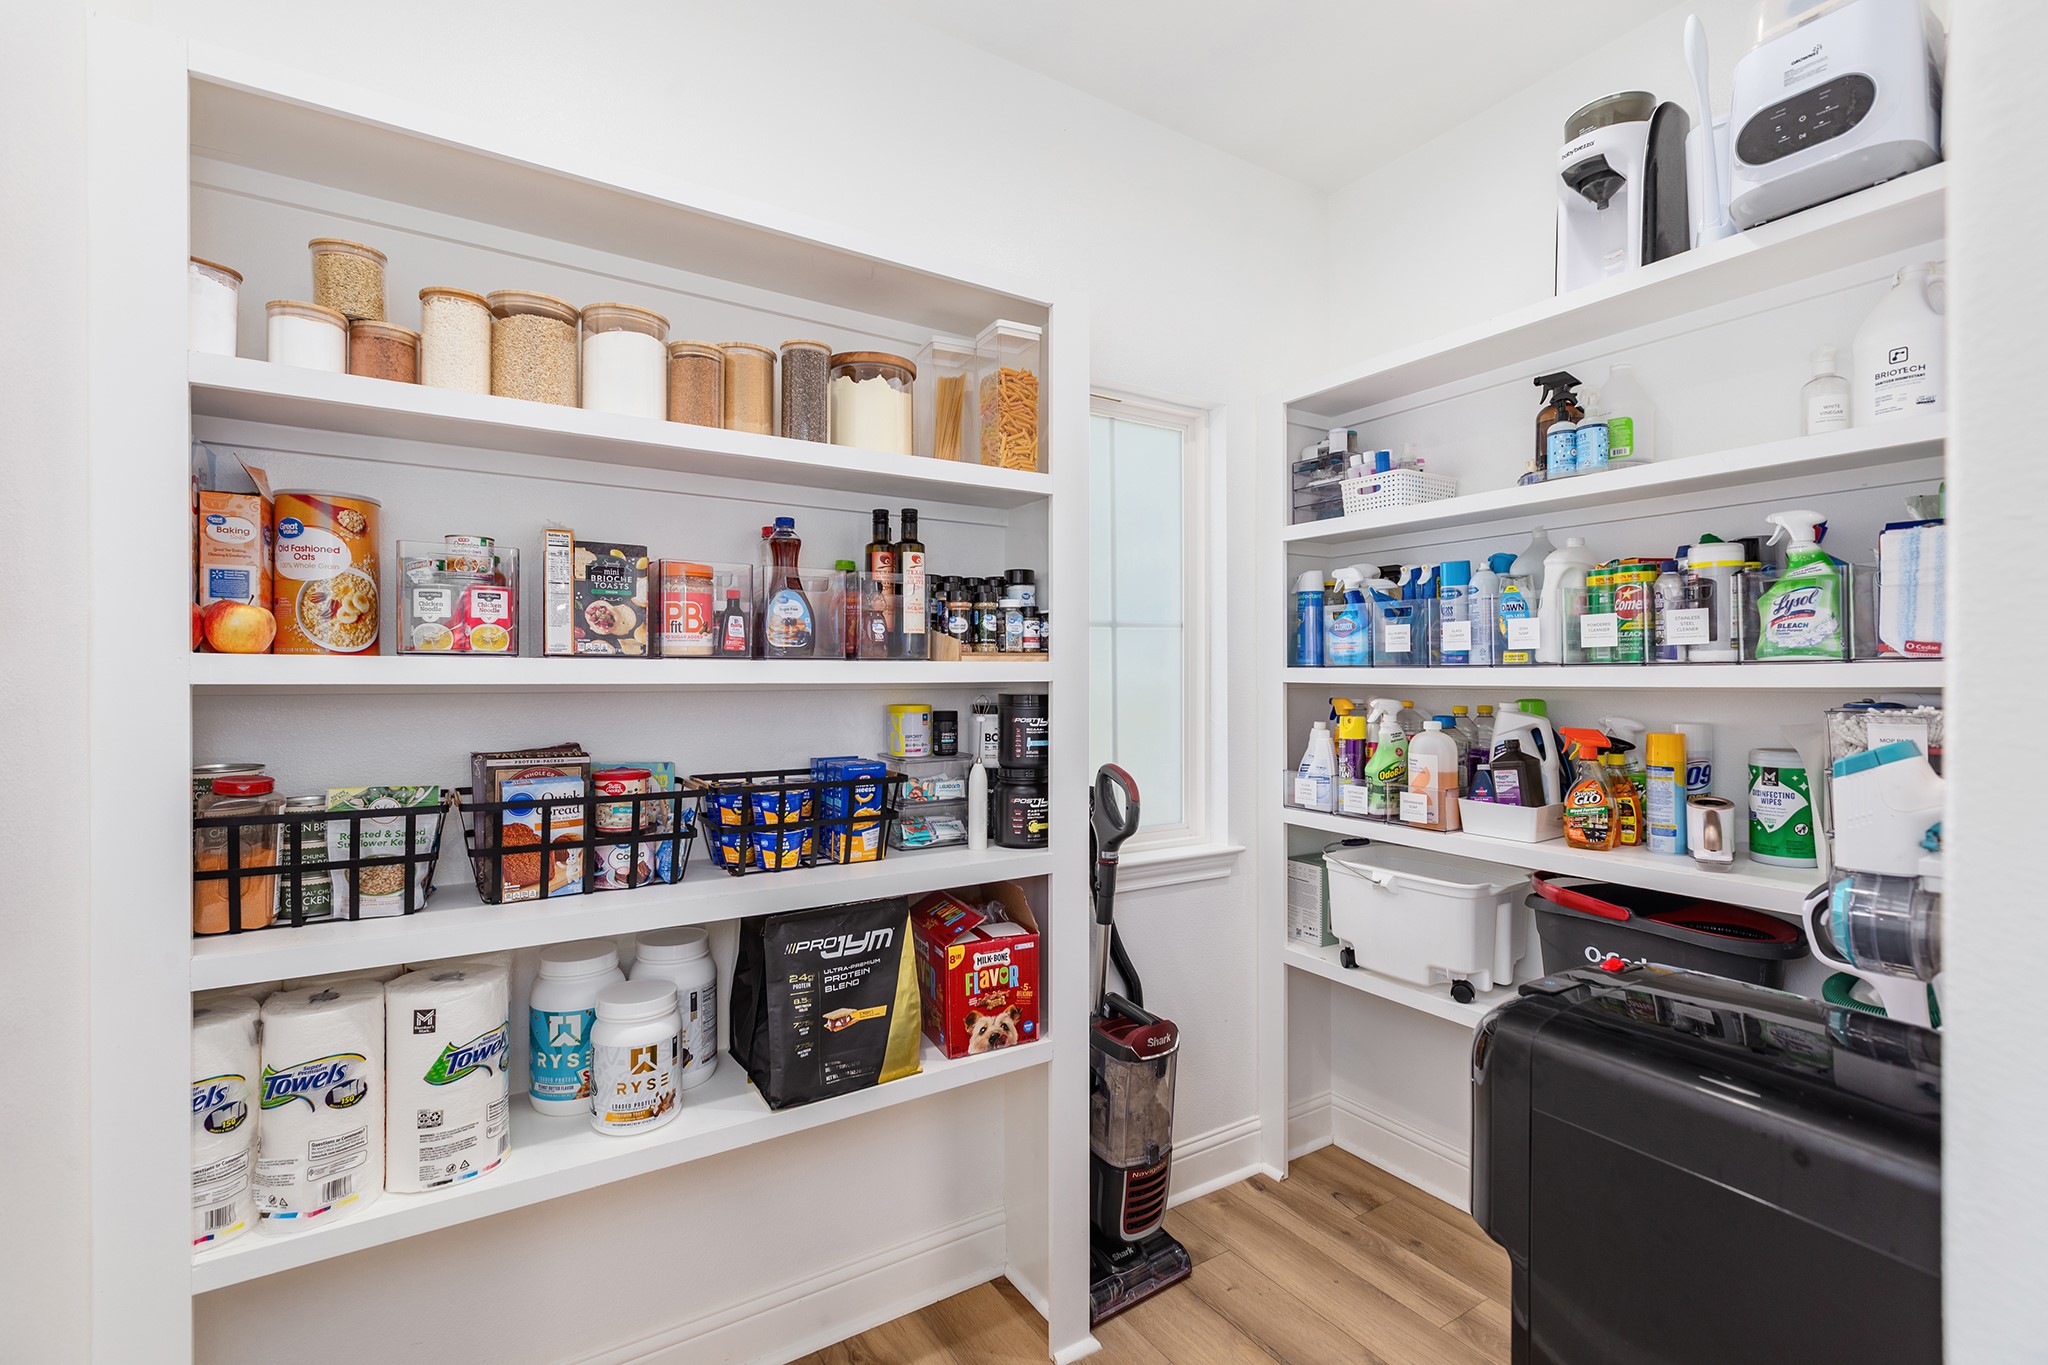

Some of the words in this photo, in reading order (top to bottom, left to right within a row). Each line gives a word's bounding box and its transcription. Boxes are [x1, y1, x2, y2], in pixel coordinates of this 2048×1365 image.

[1875, 364, 1926, 380] BRIOTECH
[216, 526, 251, 536] Baking
[290, 544, 341, 554] Fashioned
[293, 553, 316, 561] Oats
[590, 574, 633, 583] BRIOCHE
[594, 582, 630, 590] TOASTS
[1501, 603, 1525, 612] DAWN
[1614, 599, 1643, 611] Come
[1773, 589, 1820, 615] Lysol
[670, 620, 683, 634] fit
[1687, 764, 1711, 786] 09
[1574, 794, 1601, 805] GLO
[1752, 788, 1796, 800] DISINFECTING
[1760, 798, 1782, 806] WIPES
[340, 830, 382, 840] Rosted
[337, 838, 388, 849] Sulower
[949, 955, 956, 964] 8
[976, 952, 1009, 966] MILK-BONE
[823, 958, 881, 975] ULTRA-PREMIUM
[824, 967, 871, 984] PROTEIN
[792, 982, 812, 990] PROTEIN
[824, 978, 860, 993] BLEND
[1147, 1032, 1171, 1048] Shark
[263, 1062, 349, 1100] Towels
[616, 1072, 669, 1095] RYSE
[341, 1094, 355, 1104] 150
[633, 1098, 657, 1107] PROTEIN
[221, 1117, 237, 1129] 150
[311, 1139, 335, 1147] Questions
[193, 1164, 215, 1175] uestions
[1131, 1161, 1167, 1178] Navigator
[1111, 1246, 1135, 1262] Shark
